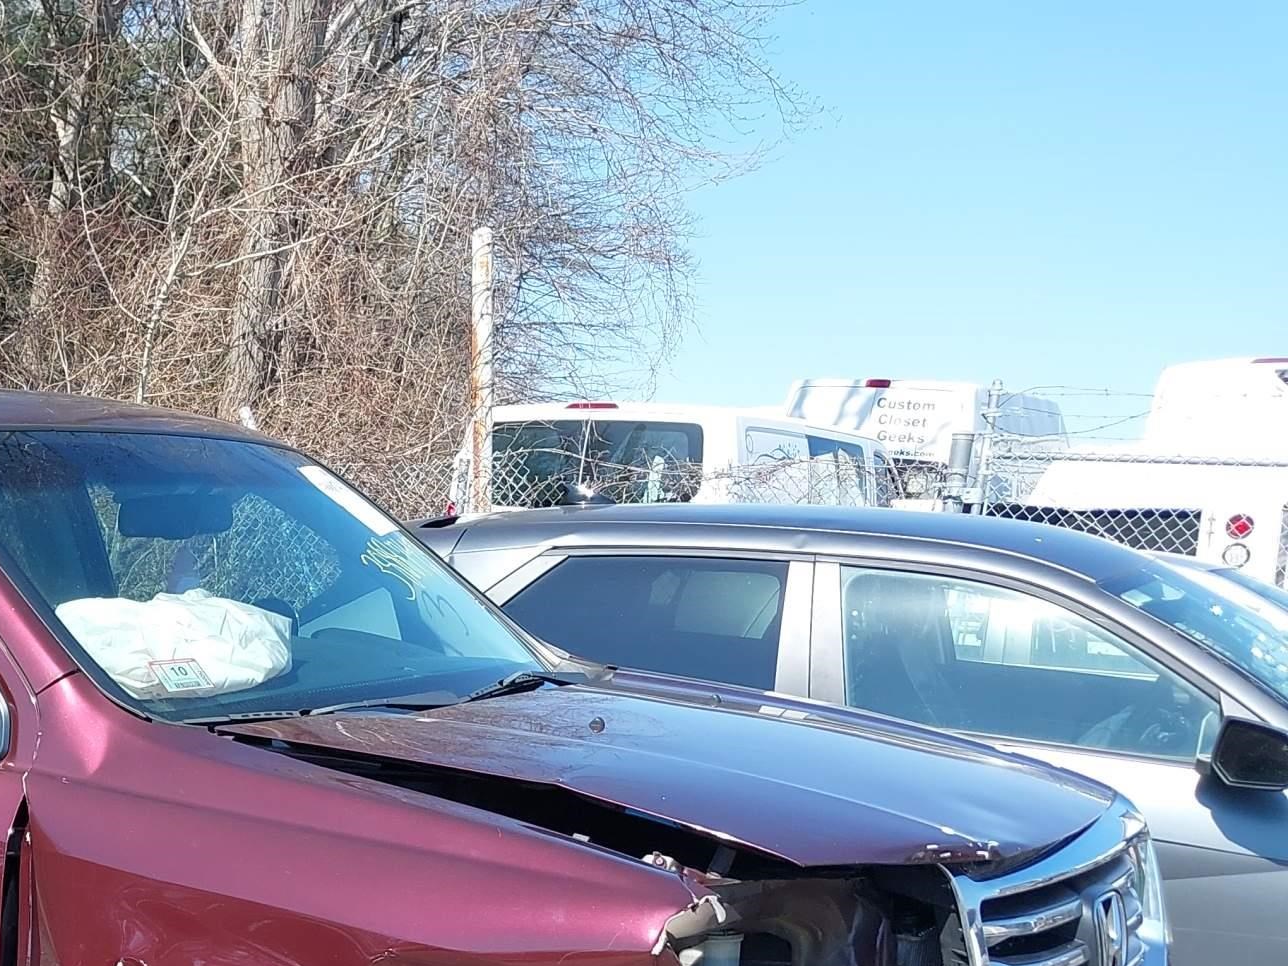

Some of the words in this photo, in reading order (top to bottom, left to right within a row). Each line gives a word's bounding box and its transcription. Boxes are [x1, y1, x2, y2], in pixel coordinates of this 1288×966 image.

[877, 397, 936, 411] Custom
[878, 414, 927, 428] Closet
[877, 430, 925, 444] Geeks
[170, 666, 189, 677] 10
